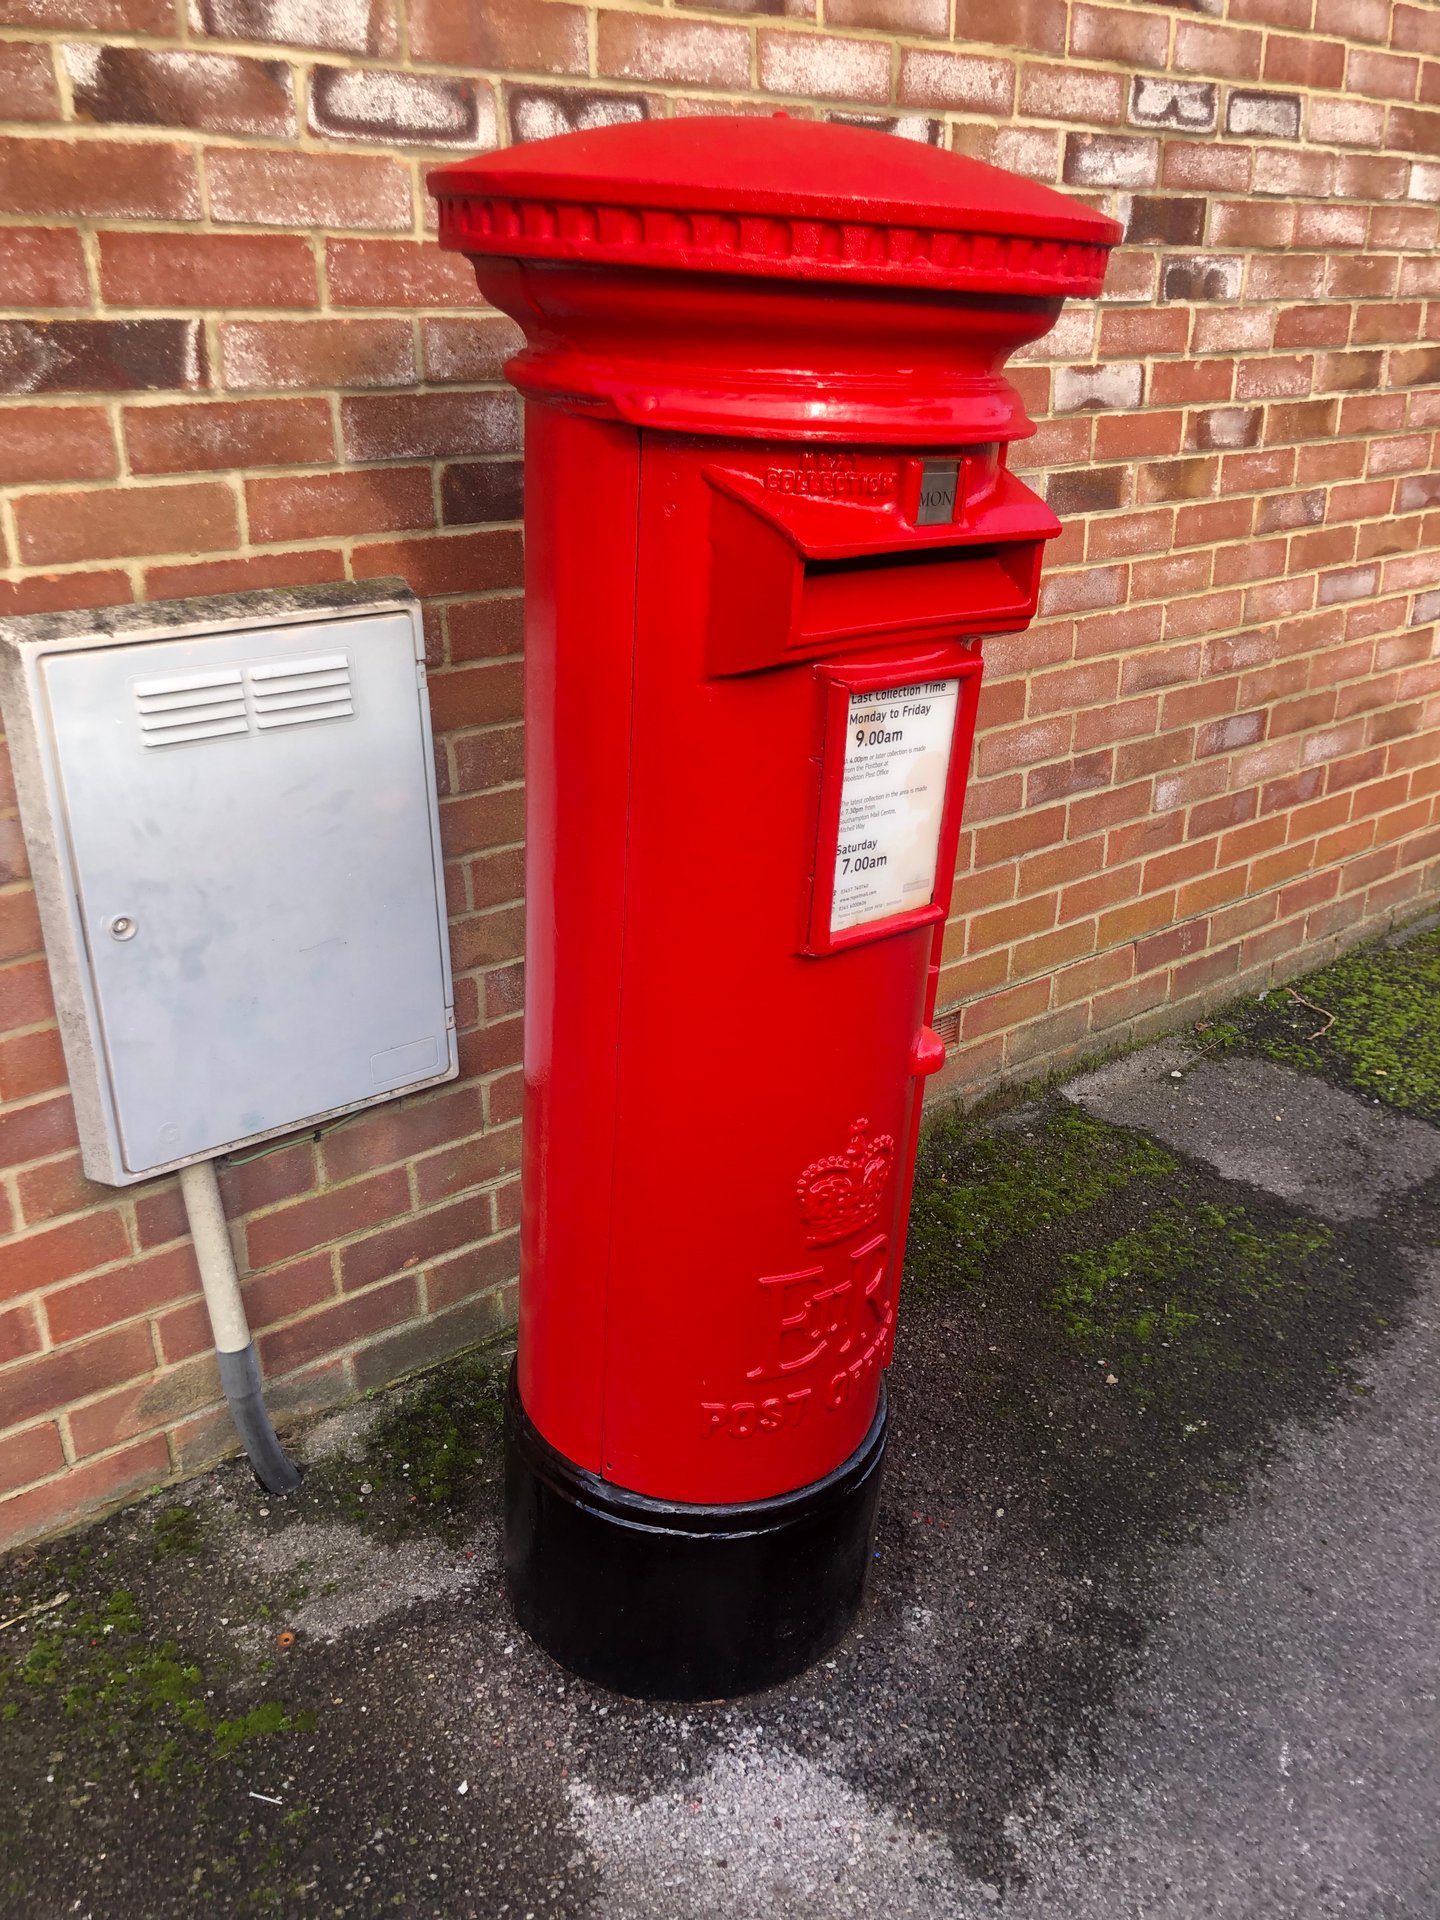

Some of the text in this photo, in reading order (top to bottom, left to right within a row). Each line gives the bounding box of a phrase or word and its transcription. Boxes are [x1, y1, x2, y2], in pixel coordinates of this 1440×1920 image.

[764, 467, 896, 497] COLLECTION
[919, 490, 953, 508] MON
[851, 681, 947, 704] Last Collection Time
[849, 703, 932, 725] Monday to Friday
[856, 729, 903, 748] 9.00am
[887, 748, 908, 758] collection
[863, 793, 884, 802] collection
[837, 839, 877, 855] Saturday
[842, 855, 887, 876] 7.00am
[700, 1387, 812, 1441] POST
